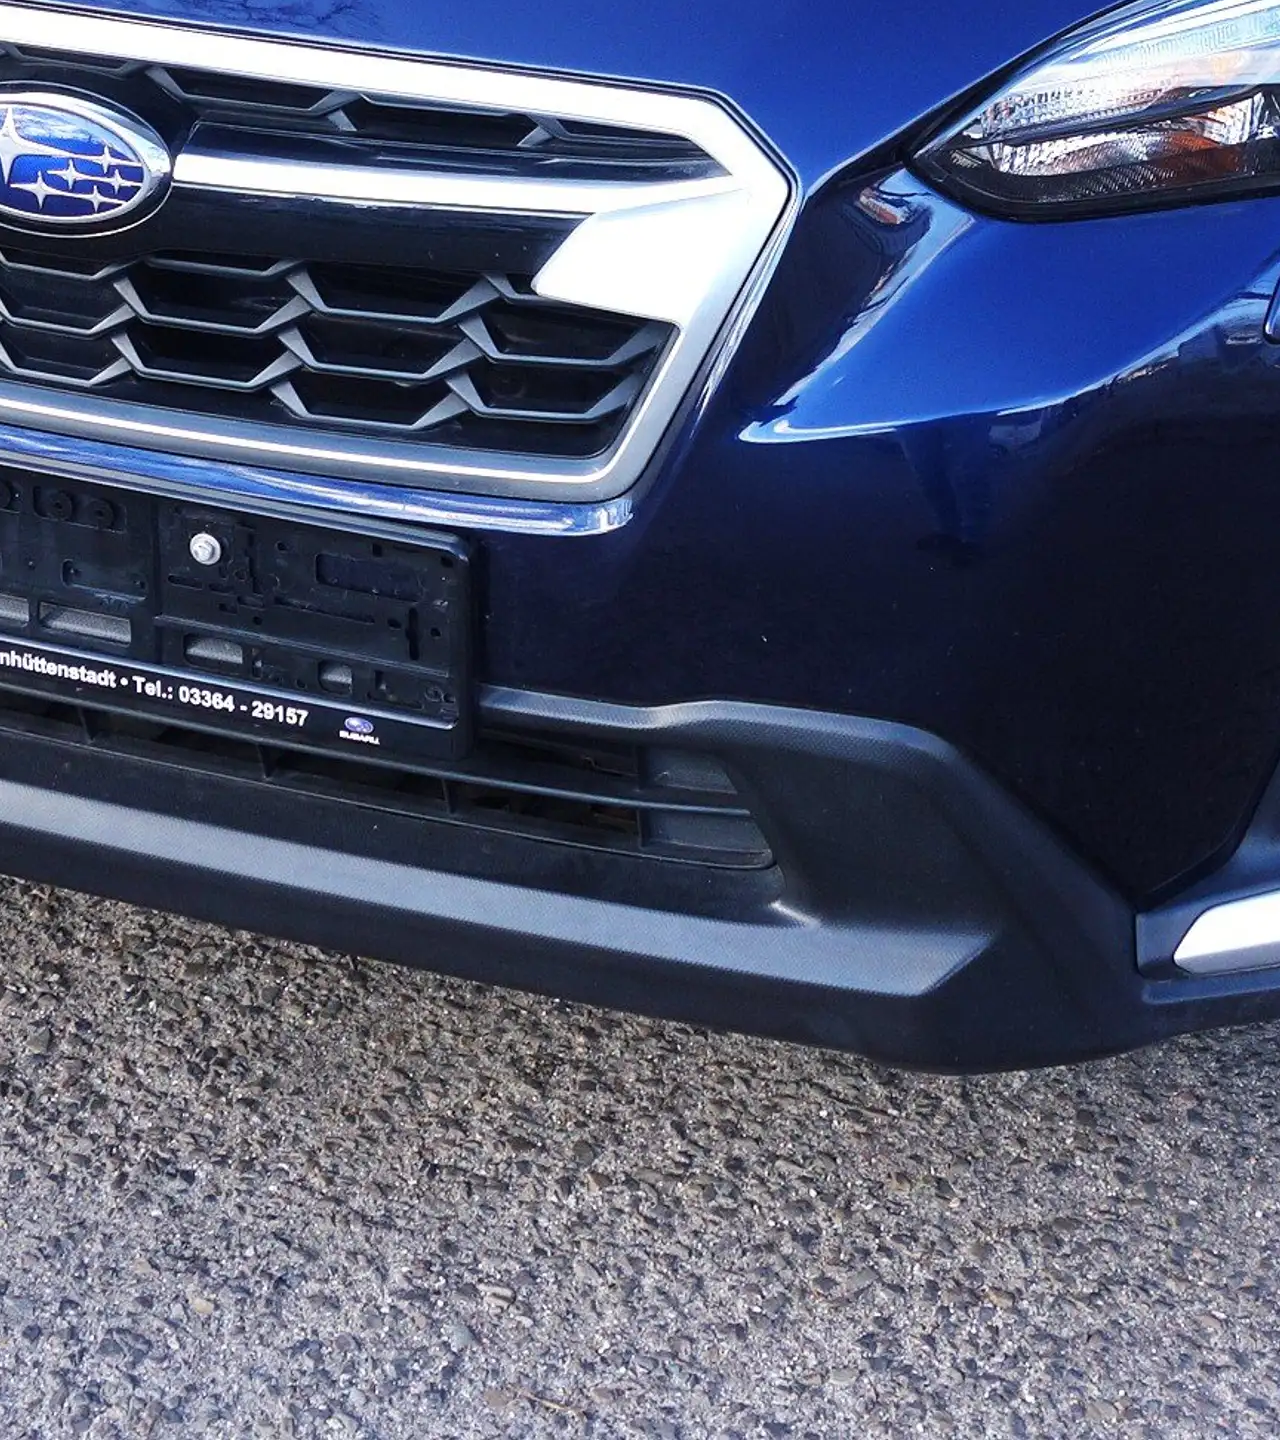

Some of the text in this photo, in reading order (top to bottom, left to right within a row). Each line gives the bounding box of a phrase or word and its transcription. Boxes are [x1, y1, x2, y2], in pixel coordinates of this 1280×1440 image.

[132, 675, 173, 700] Tel.:
[178, 685, 235, 712] 03364
[251, 700, 309, 727] 29157
